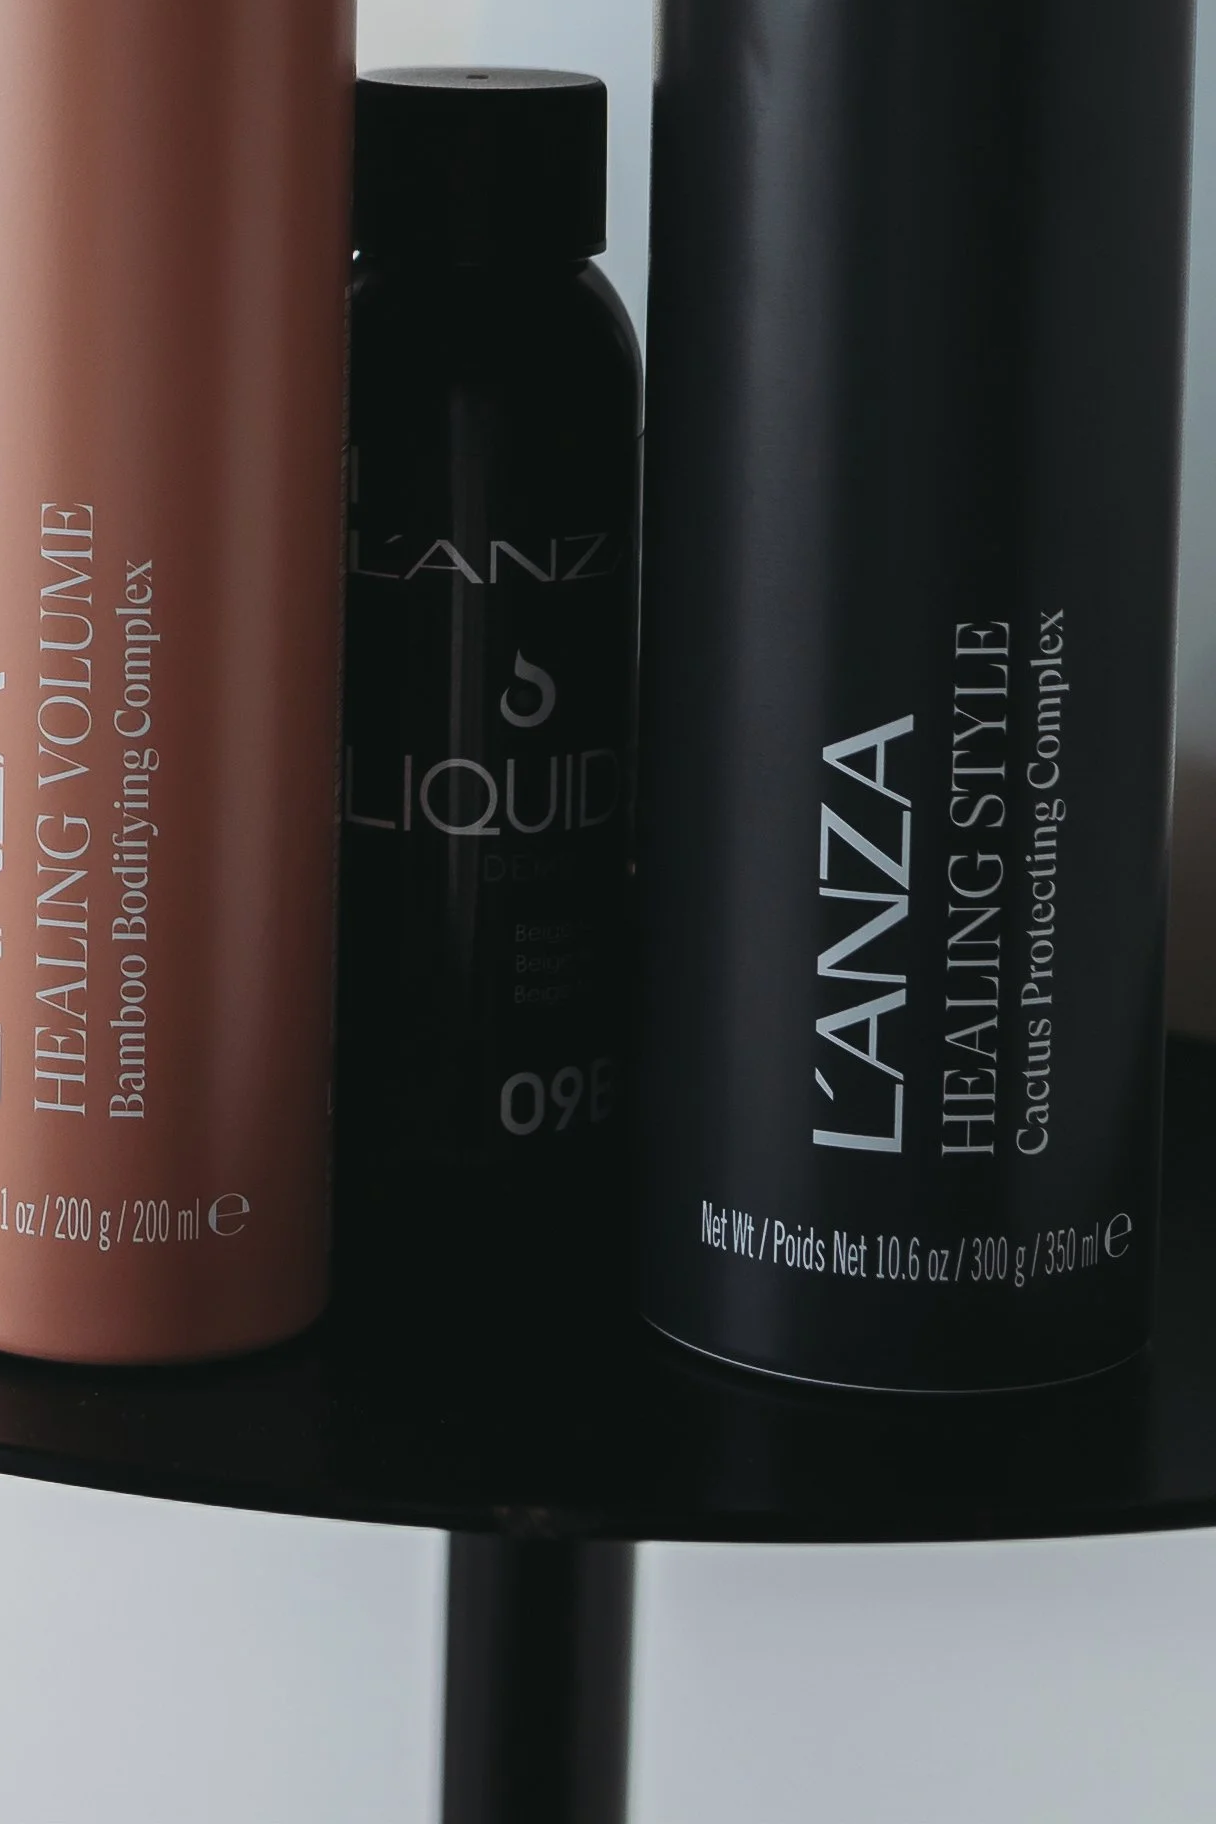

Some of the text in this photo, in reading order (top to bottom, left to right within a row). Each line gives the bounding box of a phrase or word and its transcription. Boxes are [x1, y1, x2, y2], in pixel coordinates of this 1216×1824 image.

[34, 502, 95, 1117] HEALING VOLUME
[109, 558, 160, 1120] Bamboo Bodifying Complex
[345, 744, 621, 836] LIQUID
[812, 713, 914, 1154] L'ANZA
[941, 621, 1009, 1157] HEALING STYLE
[1016, 608, 1070, 1156] Cactus Protecting Complex
[15, 1202, 35, 1235] oz
[55, 1195, 91, 1241] 200
[99, 1210, 112, 1251] g
[132, 1199, 169, 1243] 200
[178, 1197, 200, 1242] ml
[701, 1199, 727, 1252] Net
[732, 1210, 755, 1259] Wt
[773, 1220, 825, 1275] Poids
[833, 1232, 867, 1279] Net
[876, 1236, 920, 1282] 10.6
[928, 1246, 949, 1282] oz
[972, 1236, 1007, 1280] 300
[1015, 1248, 1025, 1288] g
[1045, 1228, 1076, 1275] 350
[1081, 1221, 1098, 1269] ml
